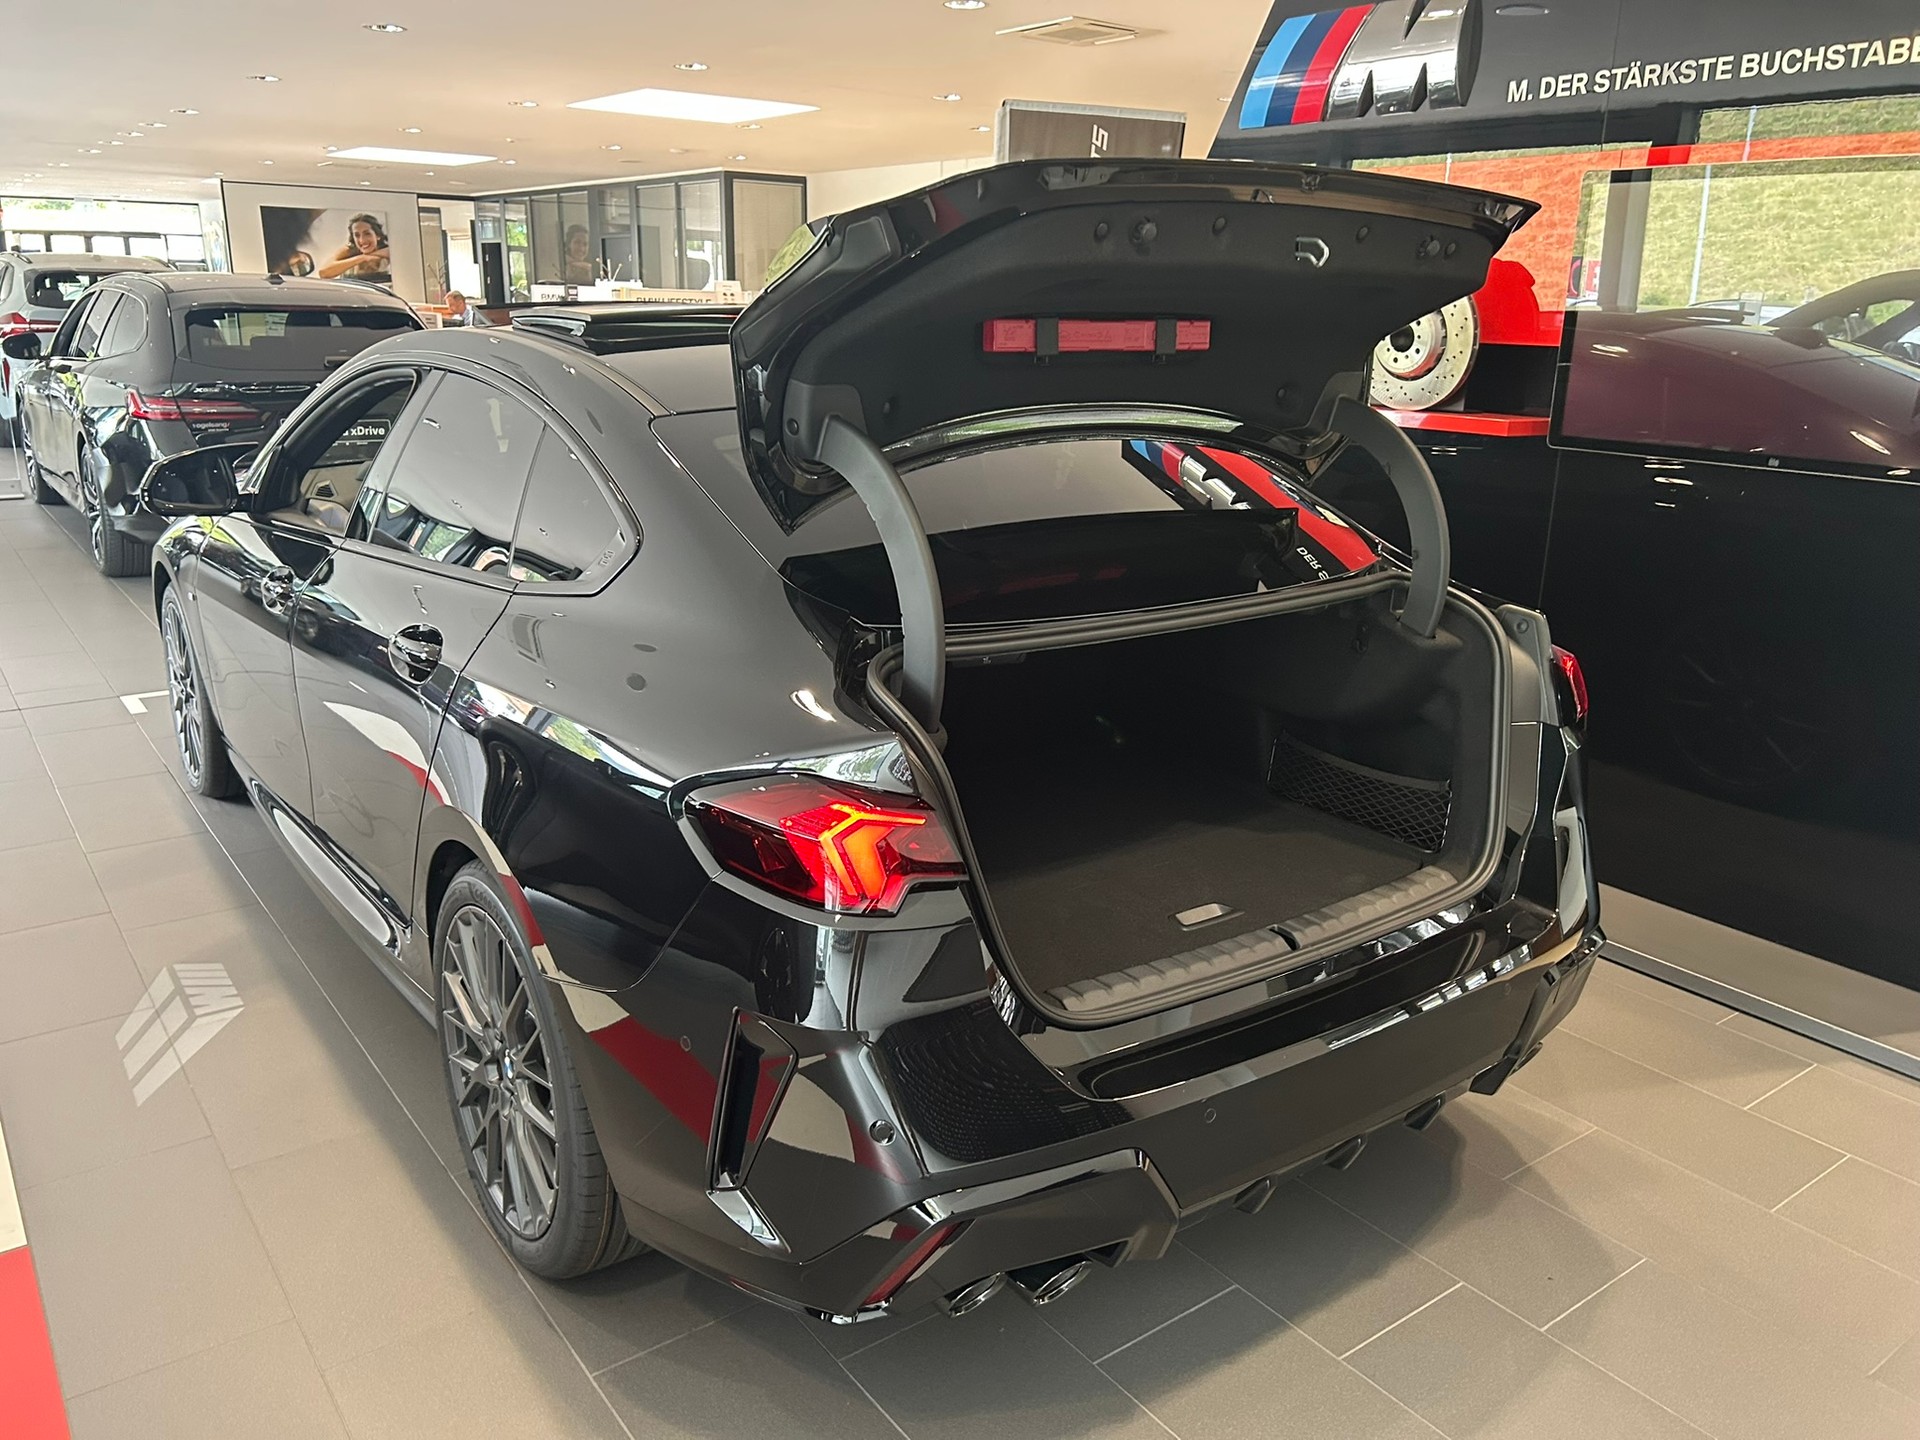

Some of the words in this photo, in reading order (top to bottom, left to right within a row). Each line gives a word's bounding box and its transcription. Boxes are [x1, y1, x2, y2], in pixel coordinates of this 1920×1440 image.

[1507, 79, 1533, 103] M.
[1539, 73, 1589, 99] DER
[1594, 55, 1735, 93] STÄRKSTE
[351, 426, 385, 436] xDrive
